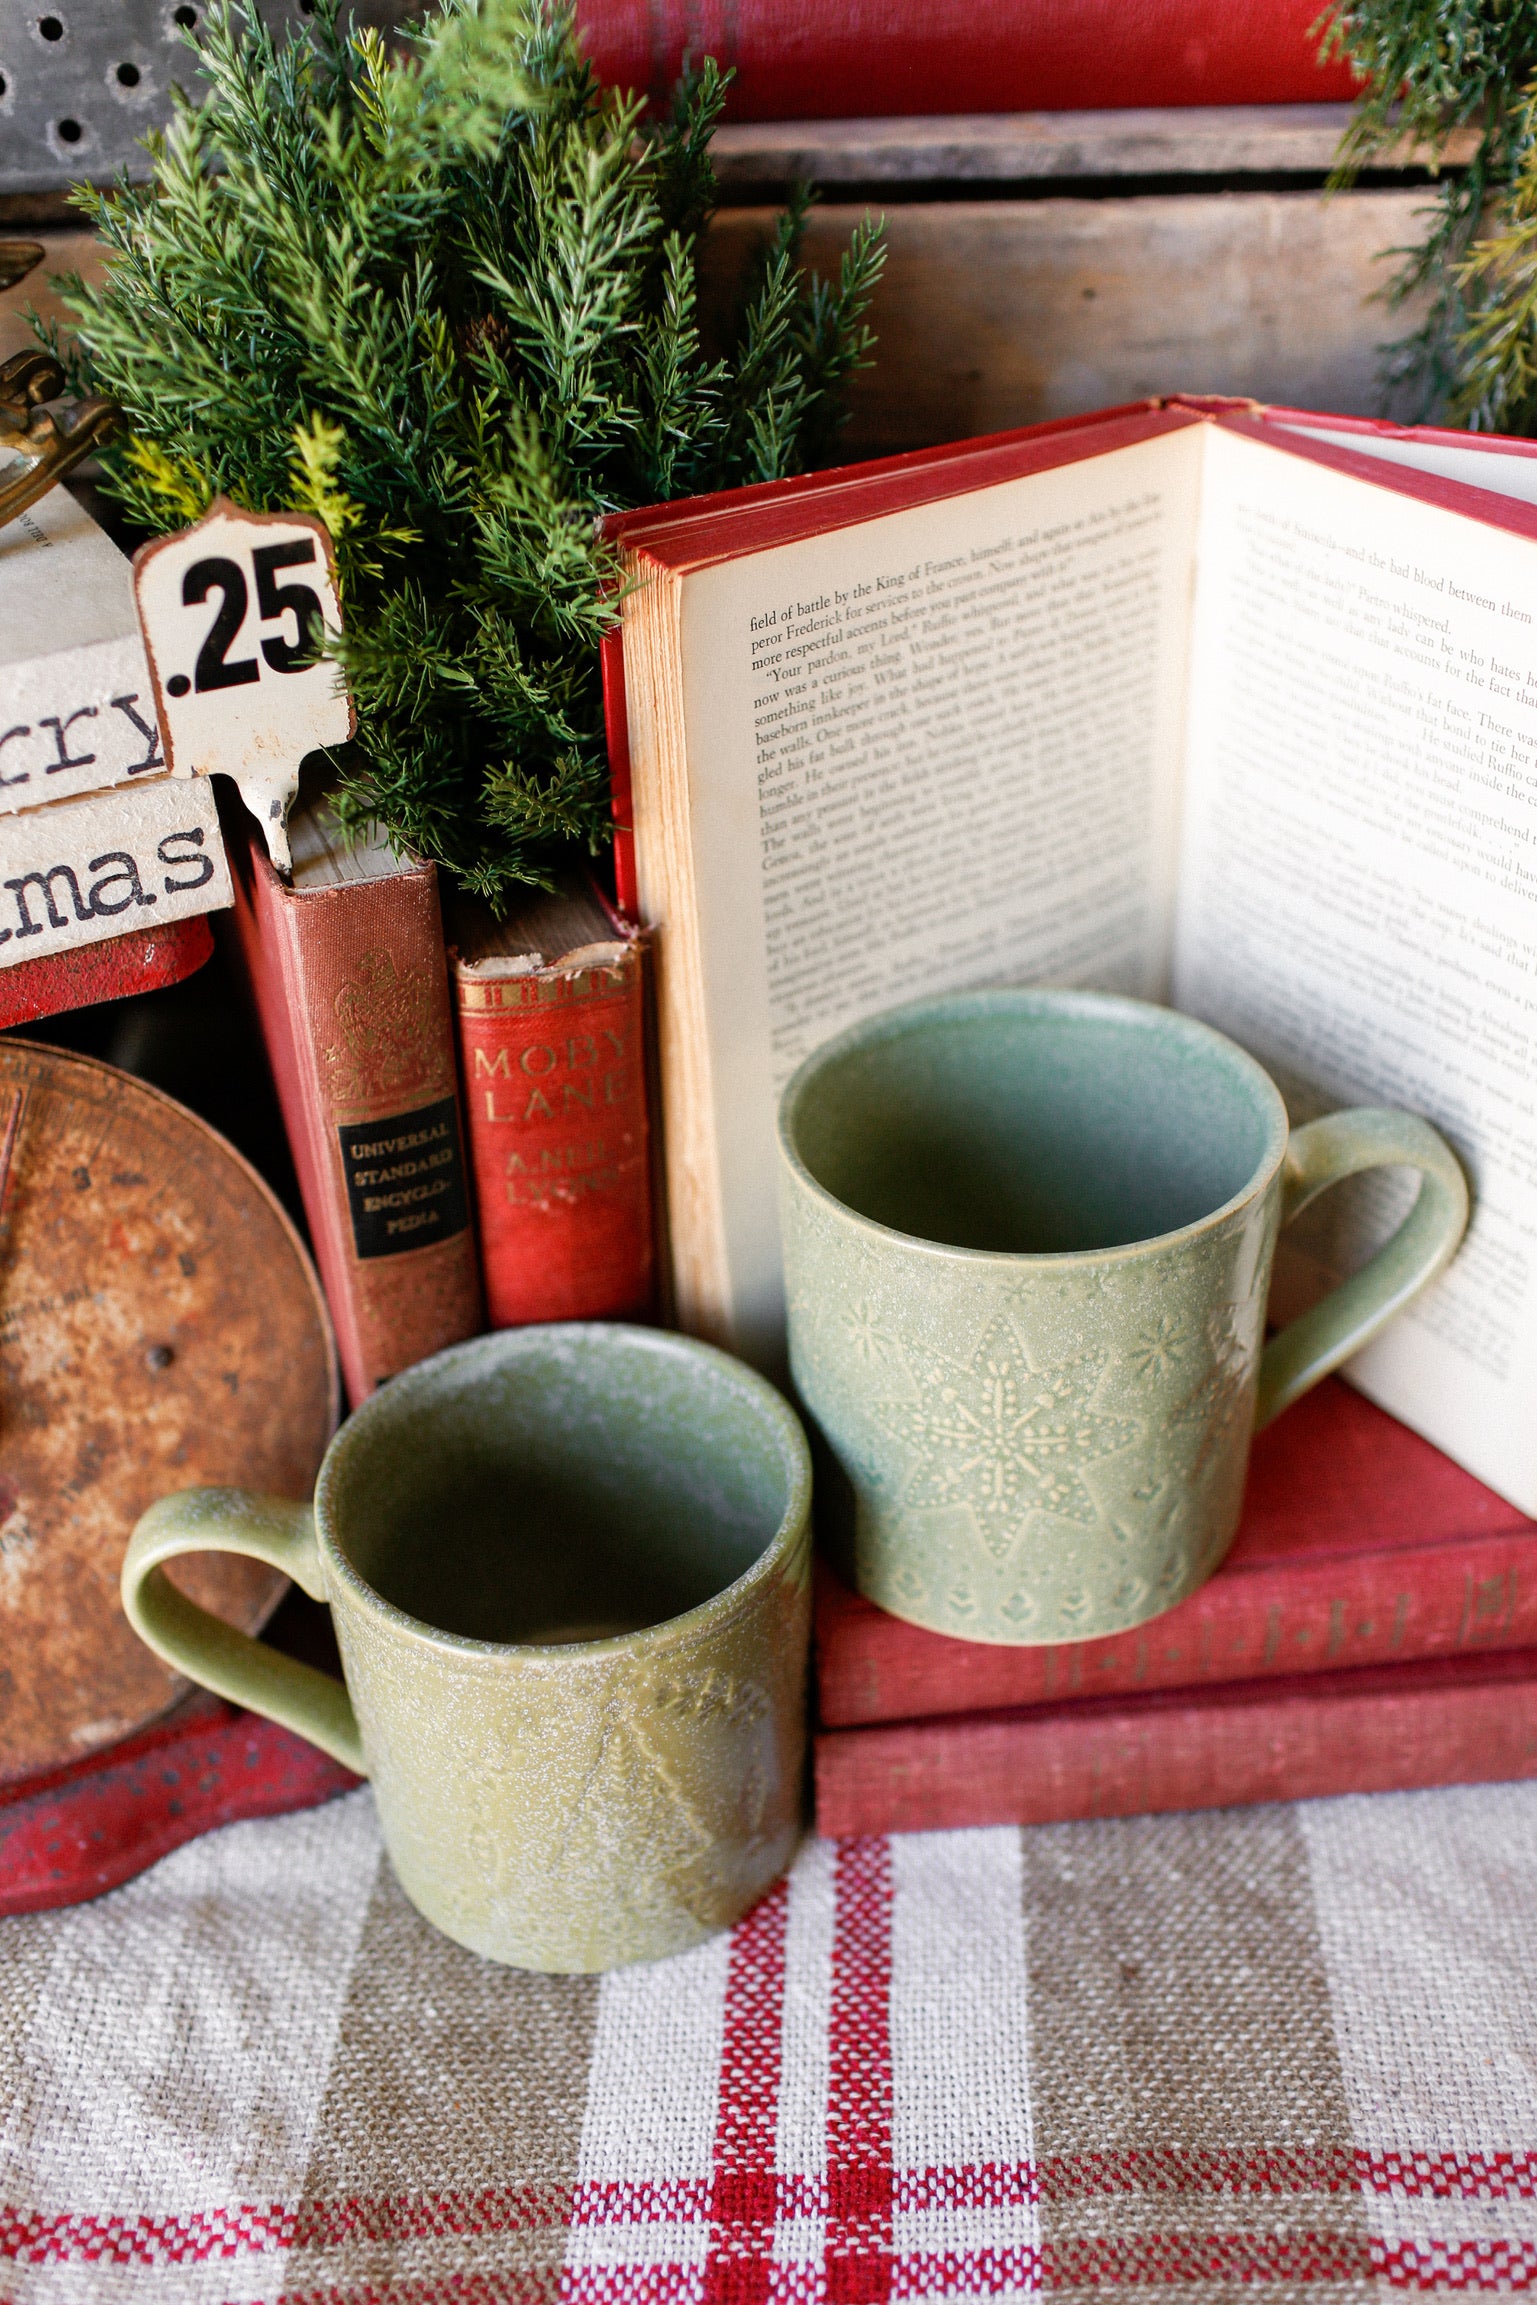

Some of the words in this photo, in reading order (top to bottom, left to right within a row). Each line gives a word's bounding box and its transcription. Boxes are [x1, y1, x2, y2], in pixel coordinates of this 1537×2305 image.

[750, 611, 777, 632] field
[781, 605, 794, 622] of
[797, 595, 831, 617] battle
[835, 590, 849, 606] by
[853, 584, 872, 599] the
[877, 576, 905, 592] King
[908, 565, 921, 580] of
[1368, 551, 1387, 569] the
[1389, 558, 1410, 579] bad
[1413, 567, 1444, 593] blood
[1448, 580, 1496, 611] between
[1501, 601, 1532, 625] them
[166, 537, 326, 698] .25
[751, 633, 783, 655] peror
[787, 611, 843, 640] Frederick
[846, 606, 863, 621] for
[866, 594, 909, 614] services
[751, 653, 783, 671] more
[785, 628, 843, 659] respectful
[847, 619, 889, 640] accents
[891, 607, 927, 625] before
[1393, 602, 1452, 635] whispered.
[1387, 616, 1411, 637] lady
[1415, 633, 1435, 649] can
[1440, 638, 1454, 656] be
[1460, 649, 1485, 668] who
[1490, 657, 1521, 681] hates
[1393, 644, 1440, 670] accounts
[1444, 659, 1461, 678] for
[1466, 669, 1485, 688] the
[1489, 677, 1511, 699] fact
[753, 692, 780, 709] now
[785, 682, 807, 697] was
[811, 679, 819, 689] a
[823, 663, 866, 684] curious
[766, 666, 802, 682] “Your
[754, 699, 816, 728] something
[821, 688, 842, 705] like
[755, 720, 808, 746] baseborn
[811, 699, 870, 727] innkeeper
[1426, 691, 1442, 710] fat
[1446, 699, 1472, 722] face.
[1477, 711, 1514, 738] There
[757, 749, 776, 764] the
[1416, 707, 1438, 728] that
[1442, 716, 1472, 740] bond
[1475, 734, 1487, 747] to
[1491, 738, 1506, 755] tie
[1510, 745, 1531, 765] her
[1421, 727, 1440, 746] He
[1442, 740, 1485, 766] studied
[1488, 754, 1524, 781] Ruffio
[757, 762, 783, 786] gled
[788, 758, 805, 772] his
[805, 768, 824, 784] He
[1469, 767, 1503, 792] inside
[1506, 783, 1526, 802] the
[1458, 804, 1530, 842] comprehend
[1476, 848, 1513, 873] would
[0, 826, 214, 946] mas
[1506, 951, 1529, 973] that
[474, 1022, 637, 1080] MOBY
[485, 1070, 629, 1122] LANE
[351, 1122, 450, 1160] UNIVERSAL
[354, 1147, 453, 1187] STANDARD
